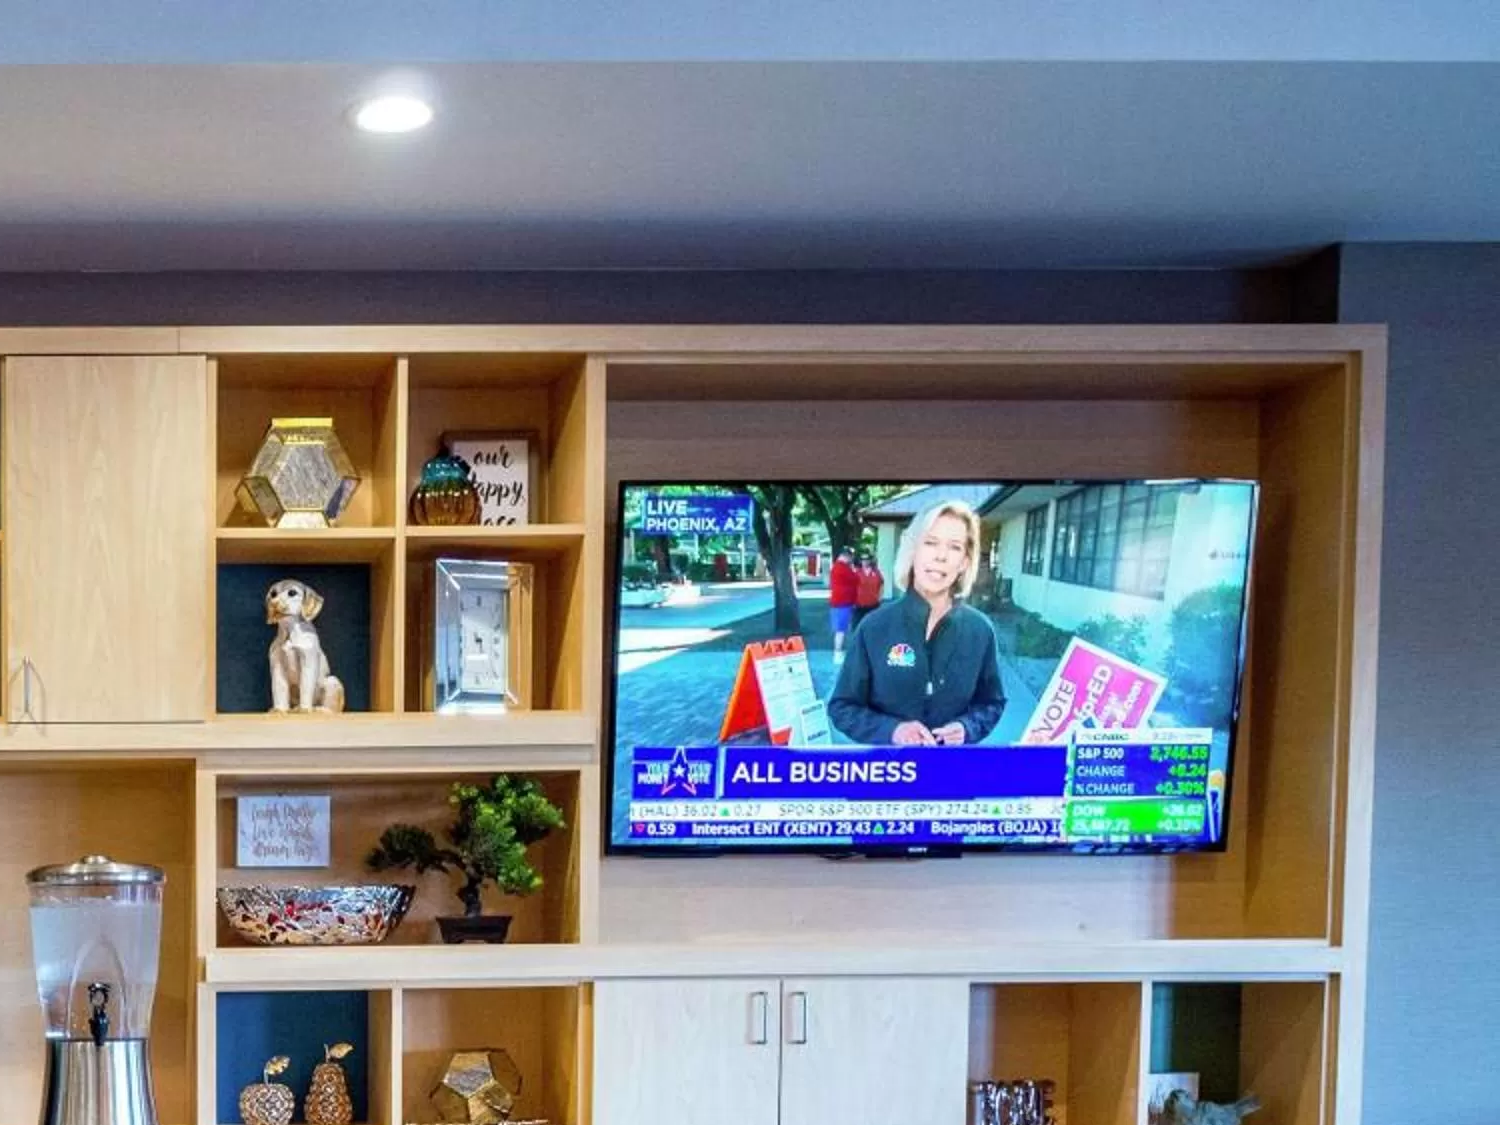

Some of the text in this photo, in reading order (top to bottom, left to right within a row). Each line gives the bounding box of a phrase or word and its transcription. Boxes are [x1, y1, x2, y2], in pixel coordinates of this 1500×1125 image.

[473, 444, 514, 469] our
[647, 500, 688, 515] LIVE
[647, 517, 746, 533] PHOENIX, AZ
[1032, 679, 1075, 734] VOTE
[1077, 747, 1101, 759] S&P
[1103, 747, 1125, 759] 500
[731, 761, 918, 784] ALL BUSINESS
[1076, 766, 1126, 777] CHANGE
[647, 822, 677, 836] 0.59
[691, 821, 915, 837] Intersect ENT (XENT) 29.43 2.24
[930, 821, 995, 836] Bojangles
[997, 820, 1047, 836] (BOJA)
